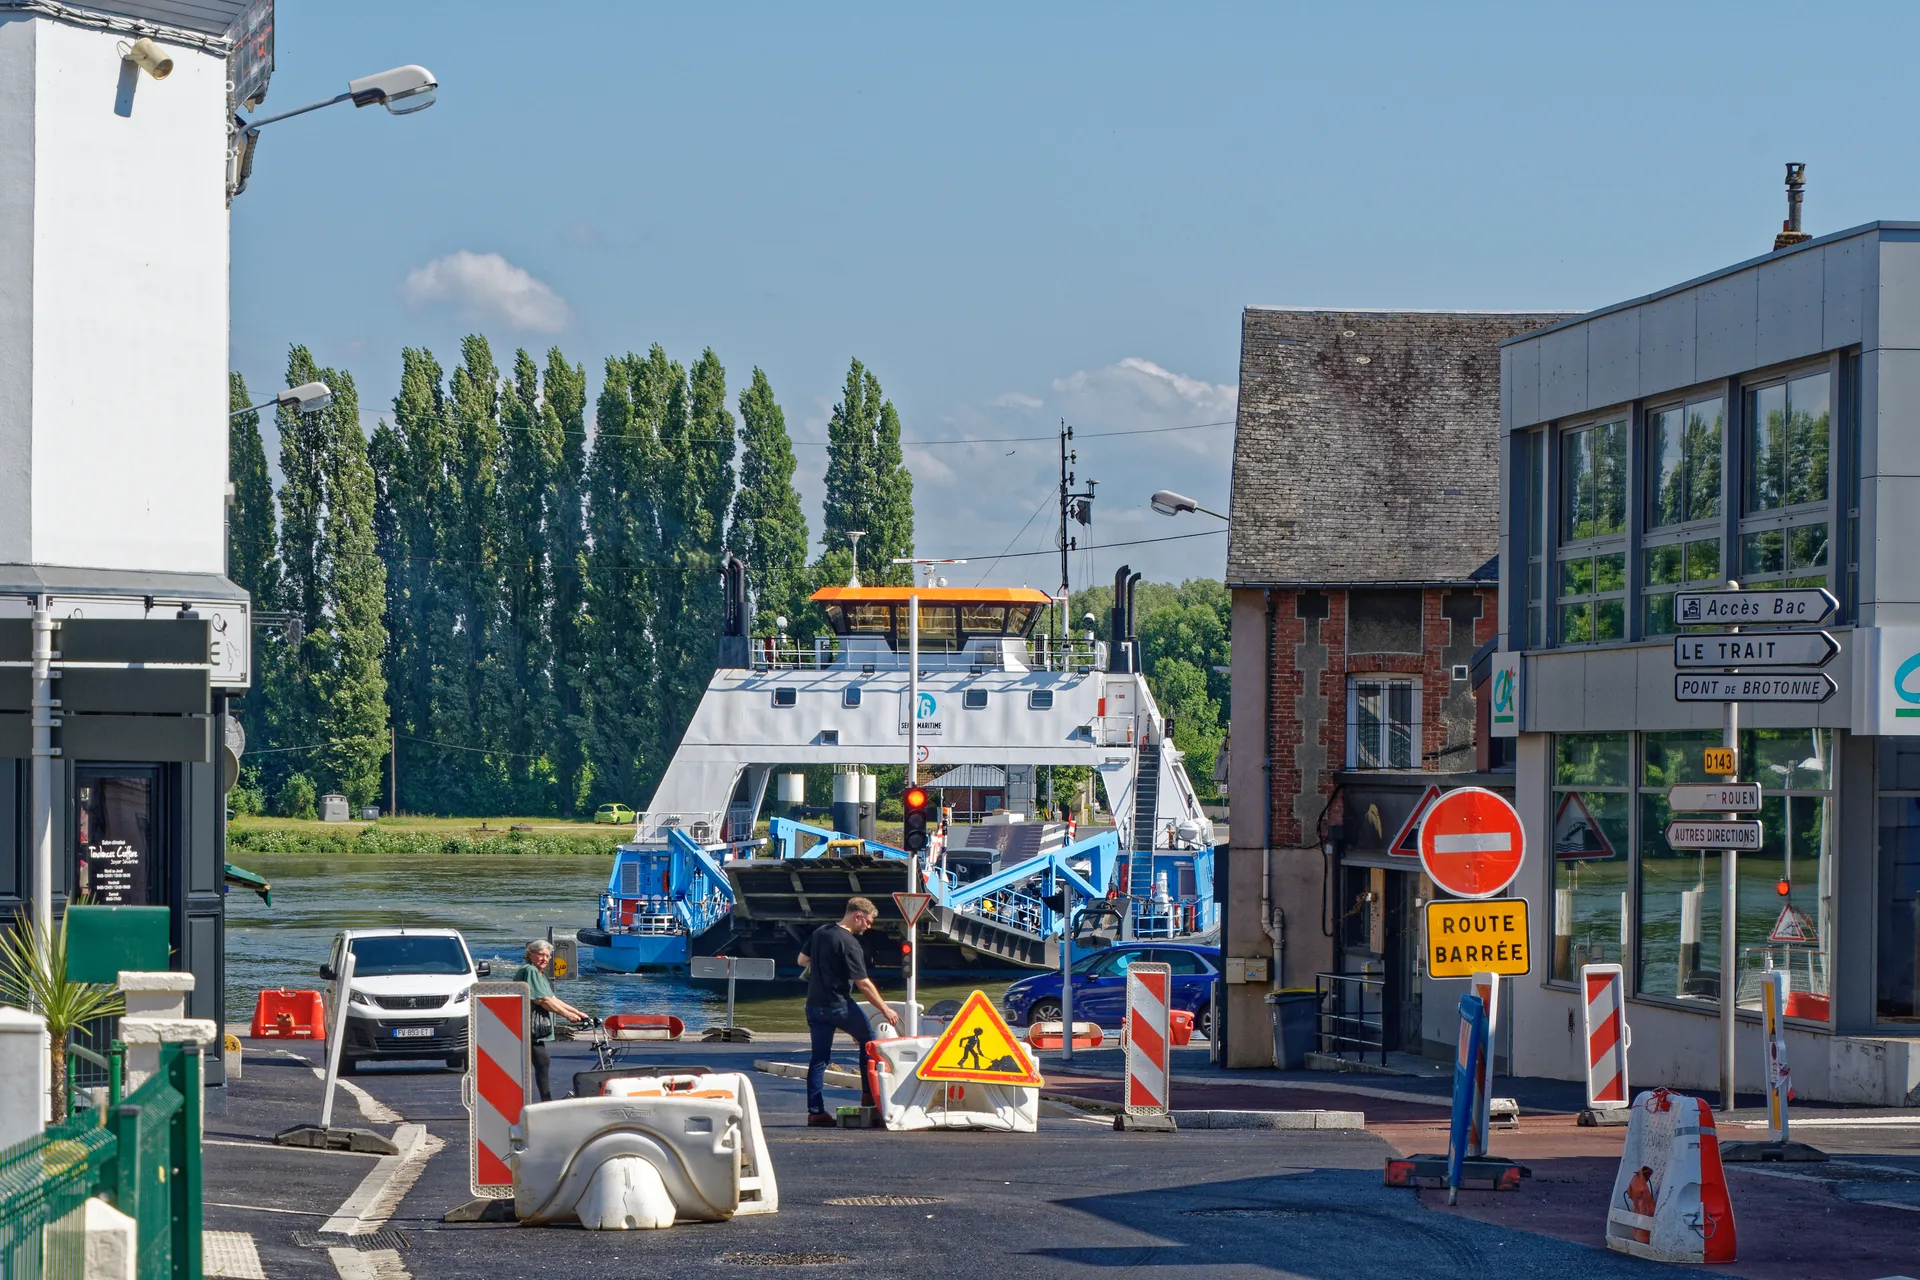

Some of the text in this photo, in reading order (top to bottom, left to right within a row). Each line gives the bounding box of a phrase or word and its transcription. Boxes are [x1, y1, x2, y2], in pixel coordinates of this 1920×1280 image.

[1707, 598, 1806, 616] Accès Bac
[1682, 642, 1776, 660] LE TRAIT
[1682, 681, 1719, 695] PONT
[1743, 681, 1820, 695] BROTONNE
[1706, 753, 1733, 770] D143
[1721, 791, 1755, 805] ROUEN
[1674, 827, 1755, 842] AUTRES DIRECTIONS
[1443, 915, 1515, 934] ROUTE
[1436, 941, 1523, 963] BARRÉE
